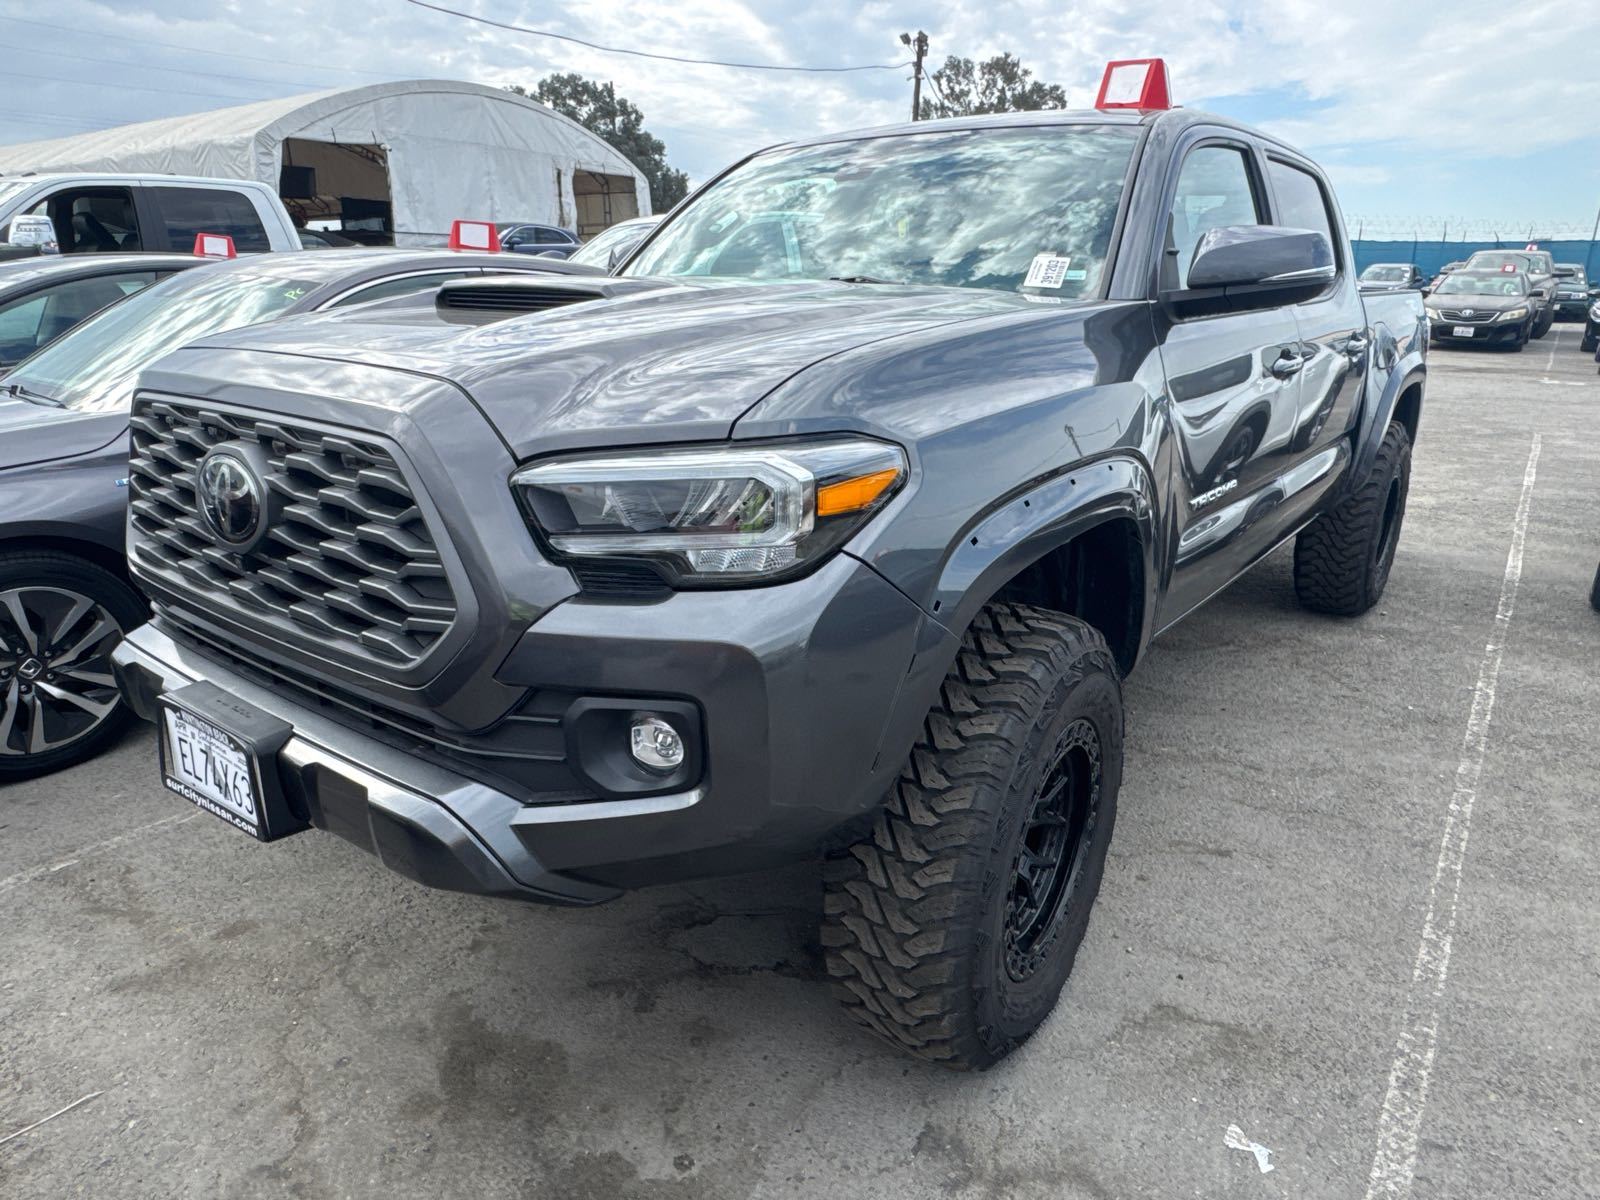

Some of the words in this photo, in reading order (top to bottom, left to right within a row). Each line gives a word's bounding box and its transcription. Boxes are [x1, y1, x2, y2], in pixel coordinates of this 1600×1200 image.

[1041, 260, 1060, 284] 391203
[1189, 479, 1238, 510] TACOMA
[178, 737, 254, 815] EL74X63
[166, 777, 258, 836] surfcitynissan.com
